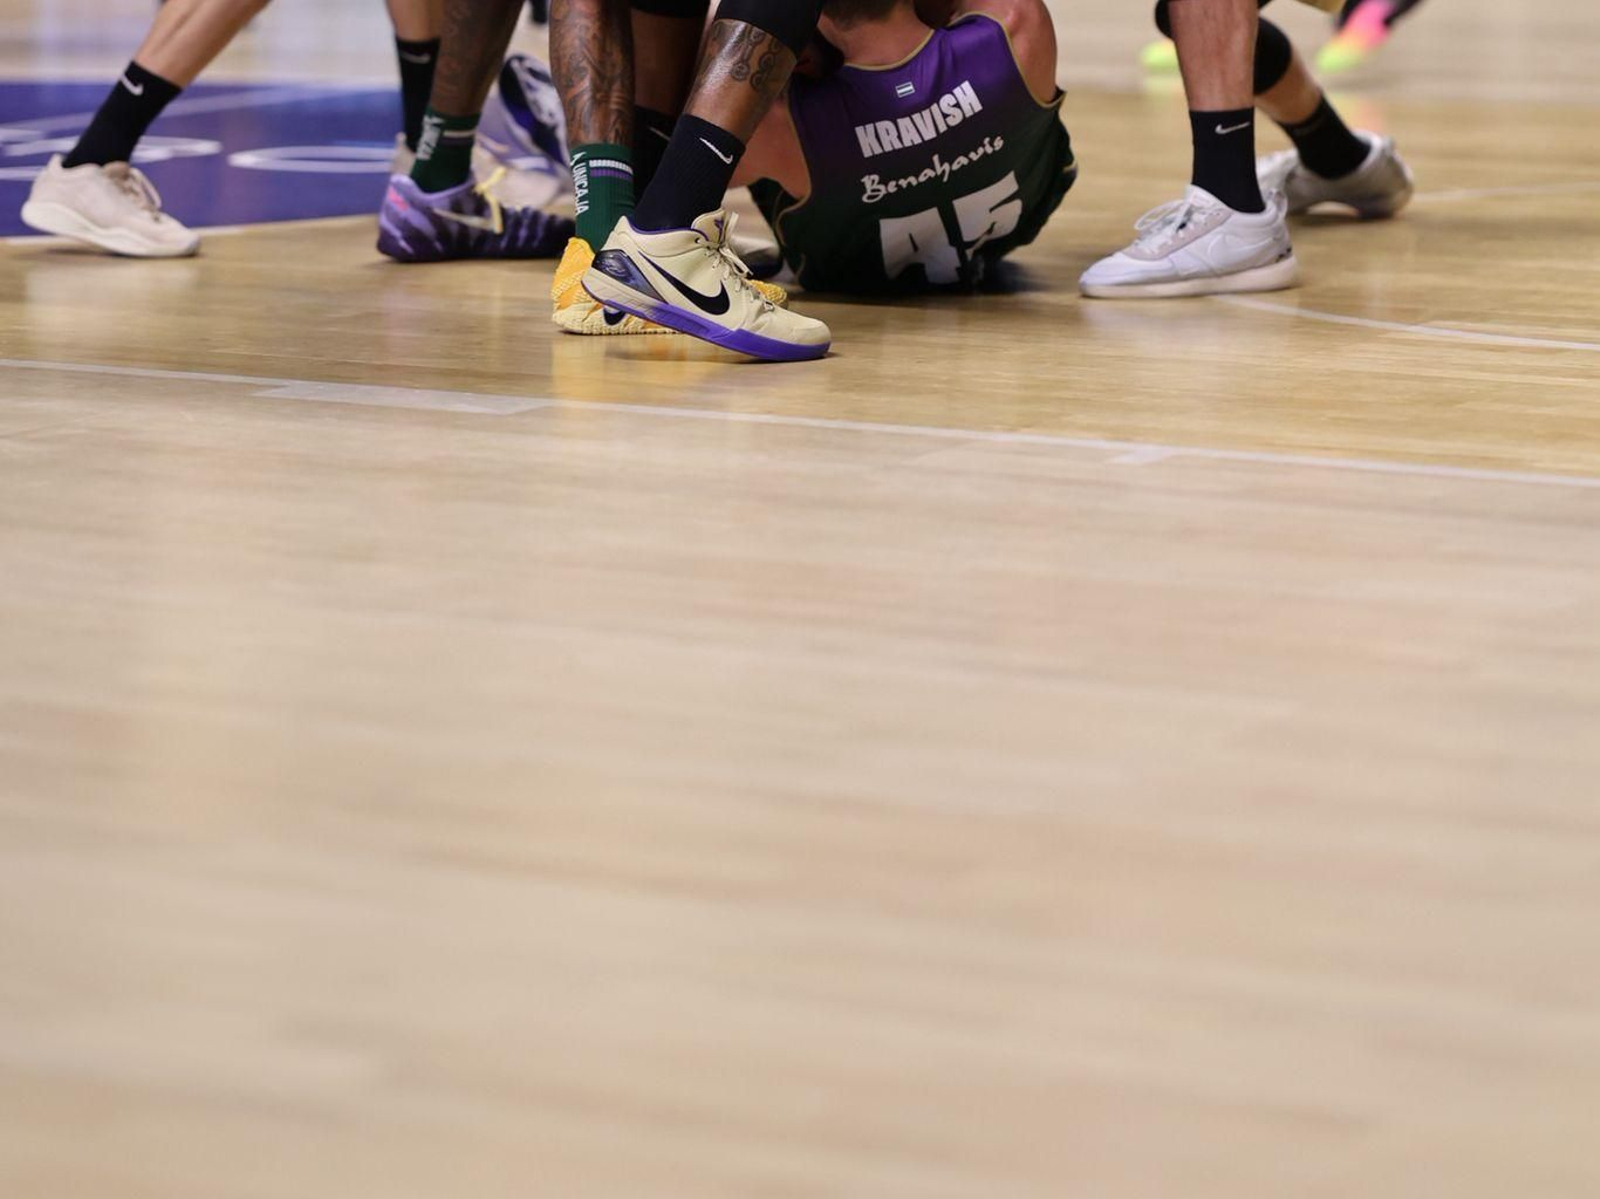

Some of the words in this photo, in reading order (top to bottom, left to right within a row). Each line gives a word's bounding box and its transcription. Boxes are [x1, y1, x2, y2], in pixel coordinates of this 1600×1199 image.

[855, 80, 983, 158] KRAVISH
[572, 161, 590, 217] UNICAJA
[879, 170, 1023, 285] 45
